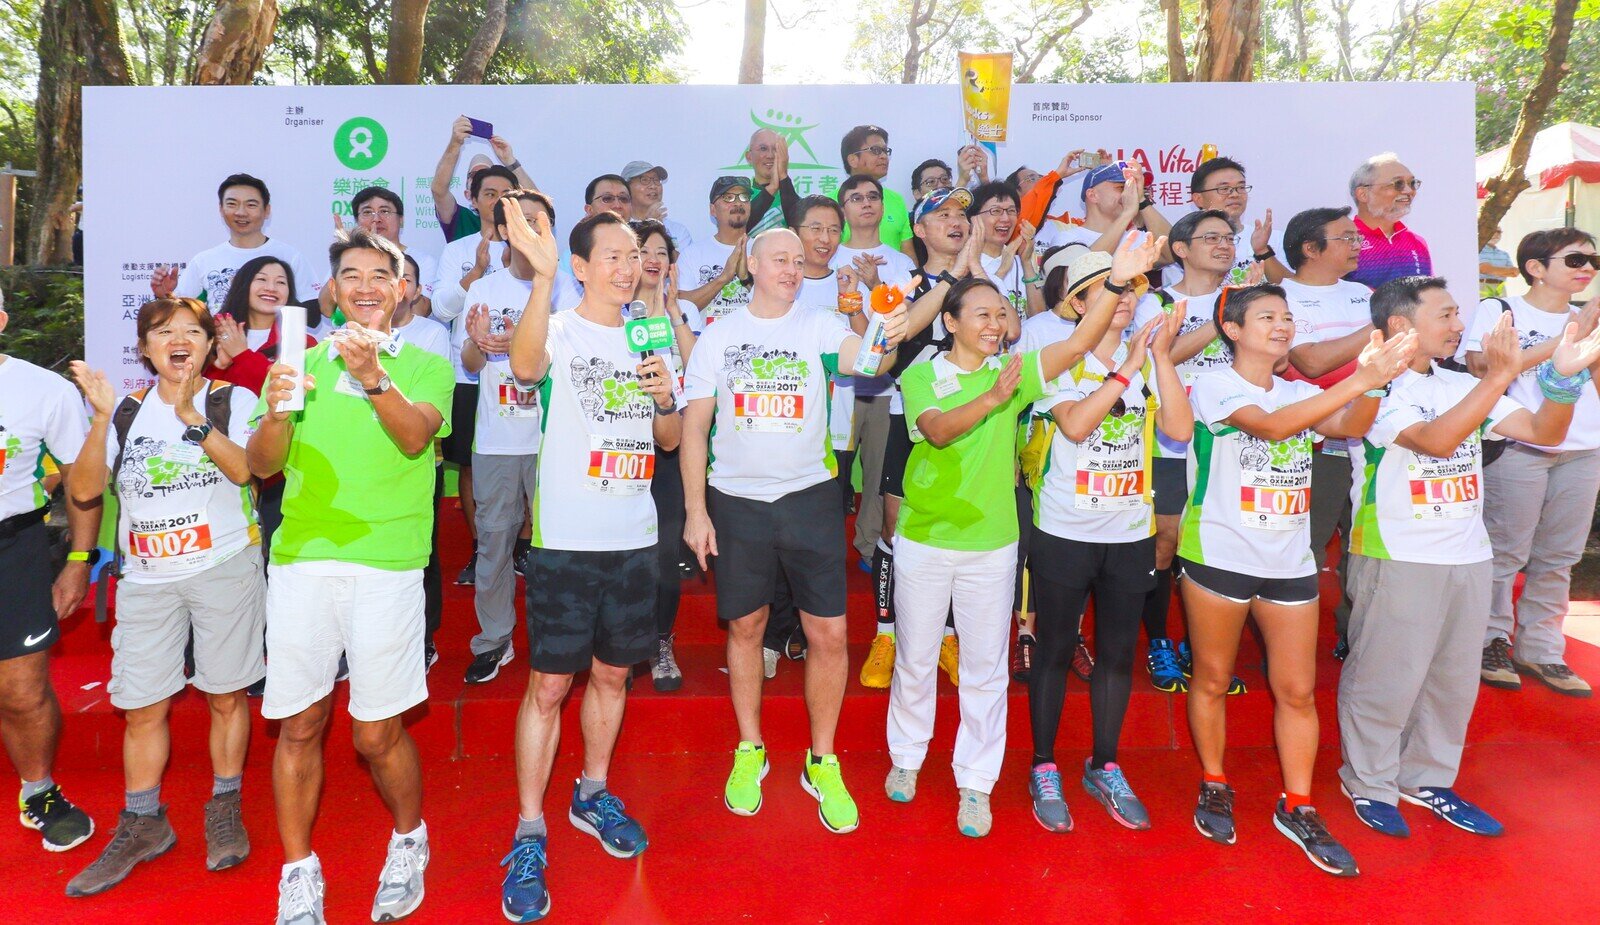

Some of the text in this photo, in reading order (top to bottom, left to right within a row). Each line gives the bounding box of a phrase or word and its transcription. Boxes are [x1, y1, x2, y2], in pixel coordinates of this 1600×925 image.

[285, 106, 304, 115] 主辦
[1033, 102, 1070, 111] 首席贊助
[284, 117, 324, 127] Organiser
[1032, 113, 1103, 123] Principal Sponsor
[1159, 144, 1204, 173] Vital
[793, 175, 839, 194] 行者
[415, 219, 440, 230] Pove
[122, 294, 158, 307] 亞洲
[776, 383, 798, 392] 2017
[743, 394, 796, 418] L008
[599, 452, 648, 479] L001
[1122, 459, 1139, 469] 2017
[1456, 463, 1473, 473] 2017
[1087, 472, 1138, 497] L072
[1424, 476, 1476, 504] L015
[1254, 488, 1306, 514] L070
[140, 521, 167, 530] OXFAM
[168, 513, 199, 528] 2017
[133, 528, 201, 558] L002
